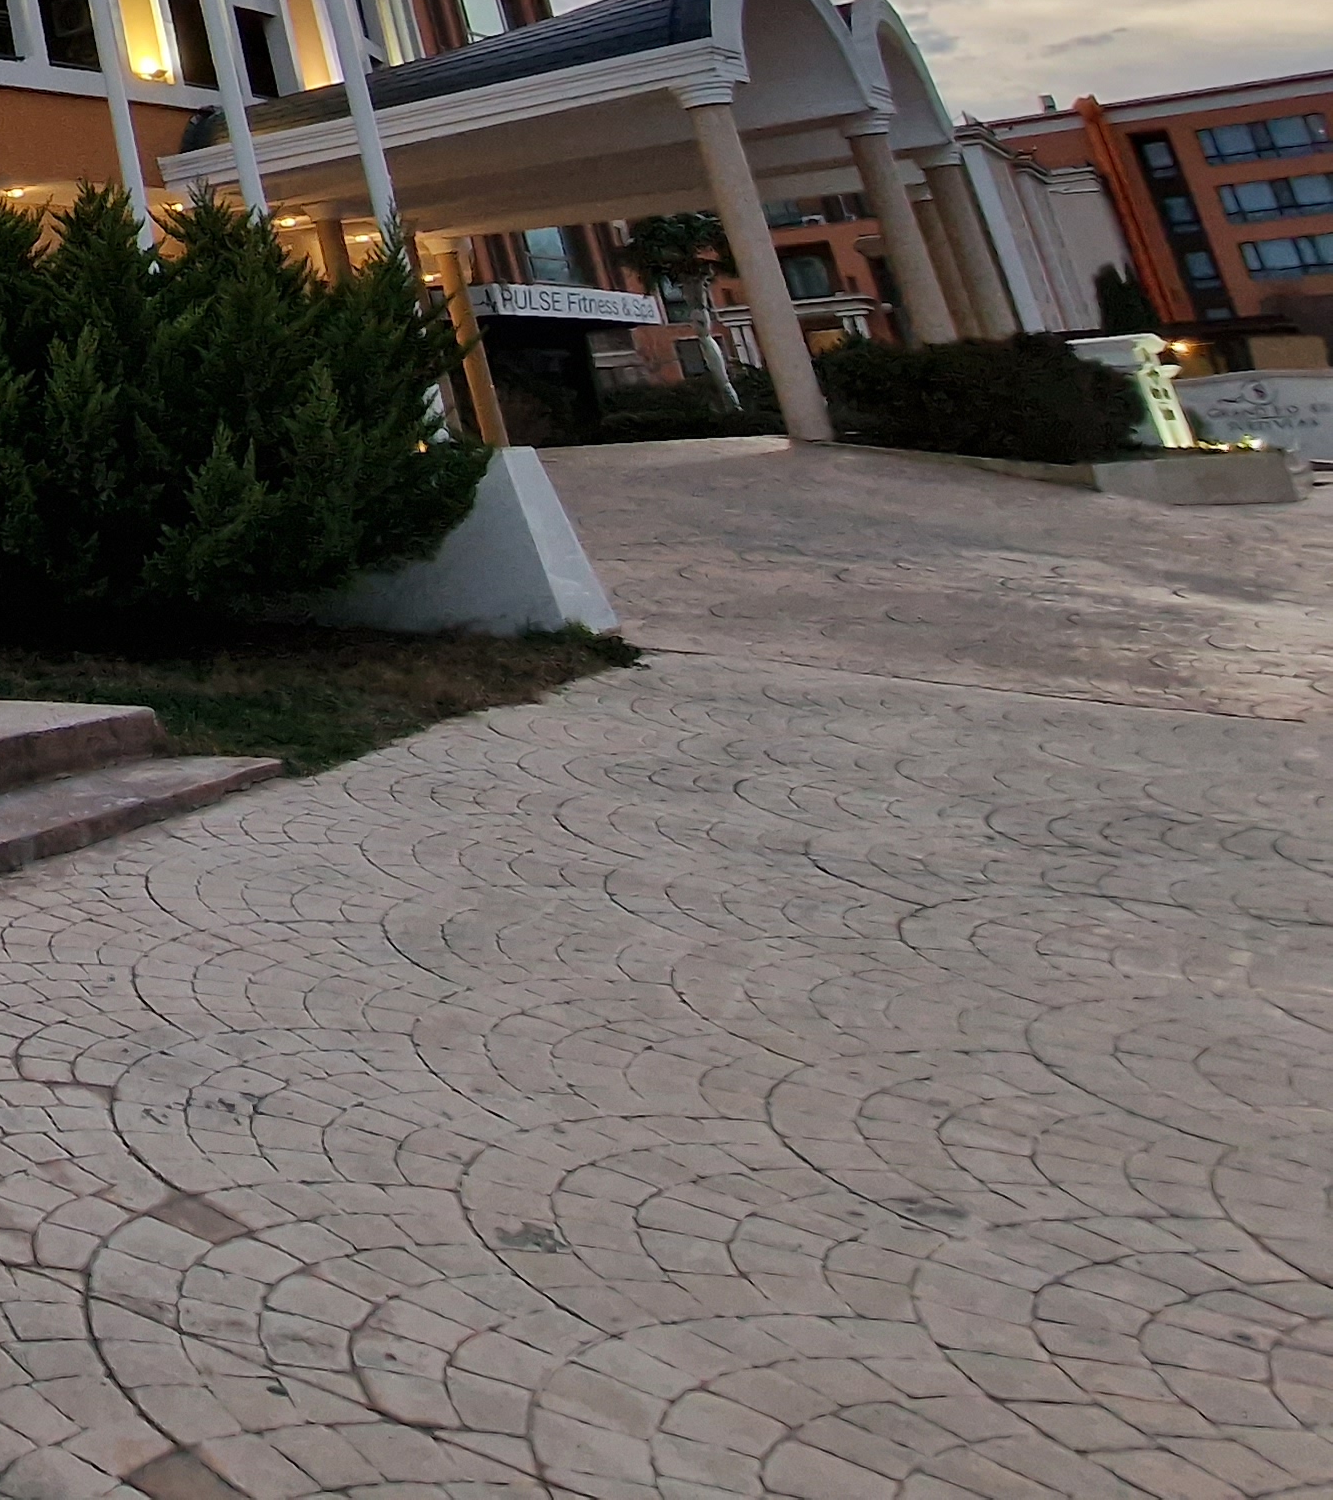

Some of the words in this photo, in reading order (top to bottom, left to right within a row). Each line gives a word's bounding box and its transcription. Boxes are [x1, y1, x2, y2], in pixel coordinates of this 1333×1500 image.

[501, 288, 563, 312] PULSE
[567, 292, 620, 316] Fitness
[621, 297, 631, 317] &
[633, 299, 655, 320] Spa
